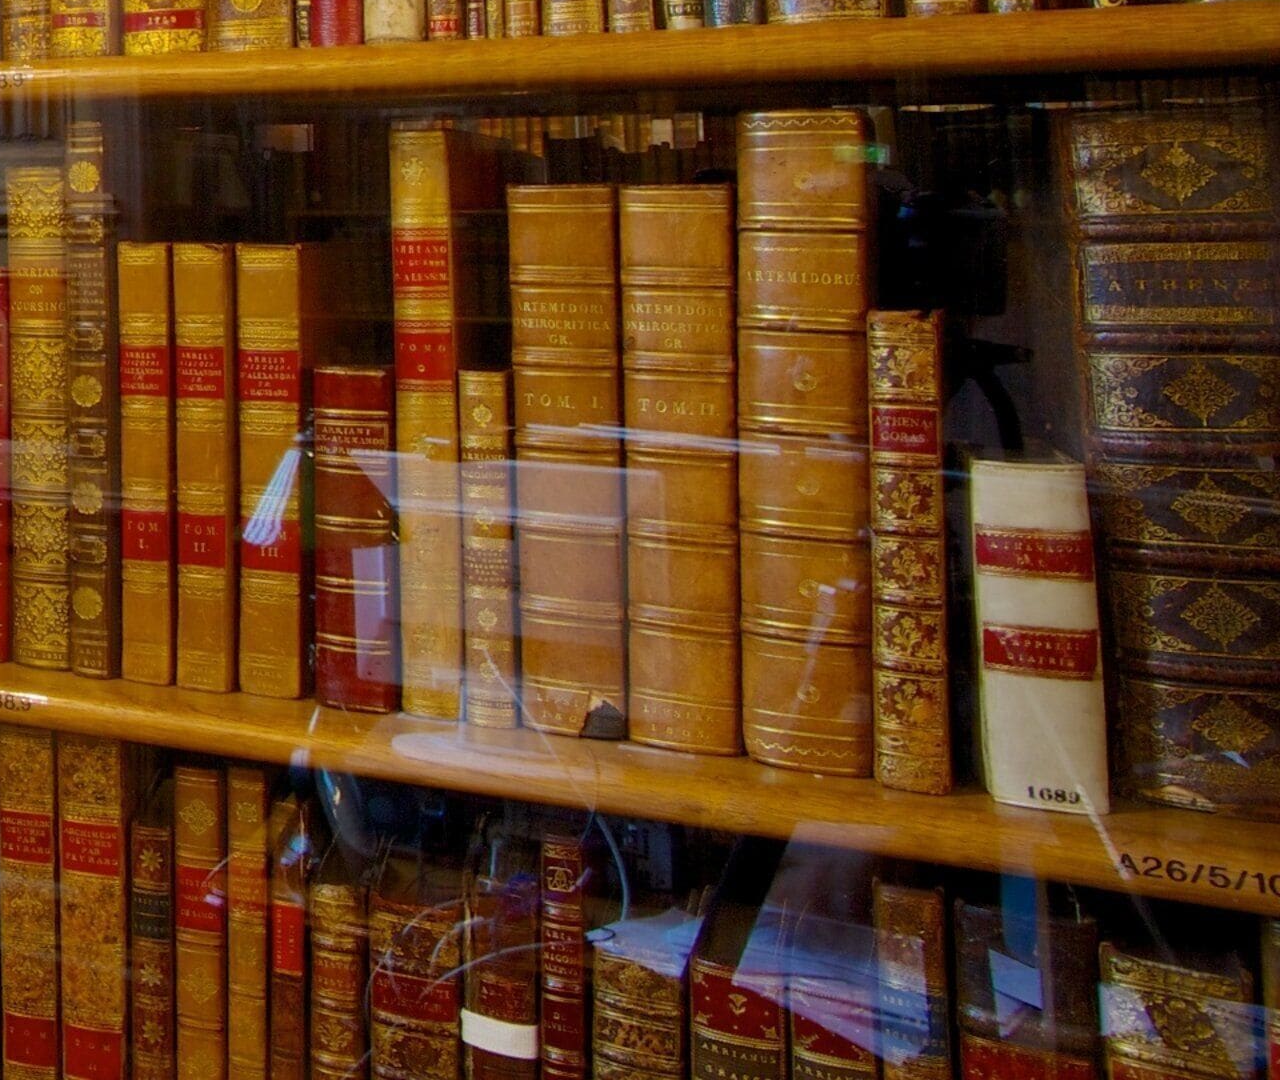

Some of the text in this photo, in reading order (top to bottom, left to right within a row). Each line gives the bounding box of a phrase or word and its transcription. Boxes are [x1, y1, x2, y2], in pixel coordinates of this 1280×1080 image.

[524, 393, 575, 410] TOM.
[639, 398, 694, 416] TOM.
[1026, 785, 1081, 805] 1689
